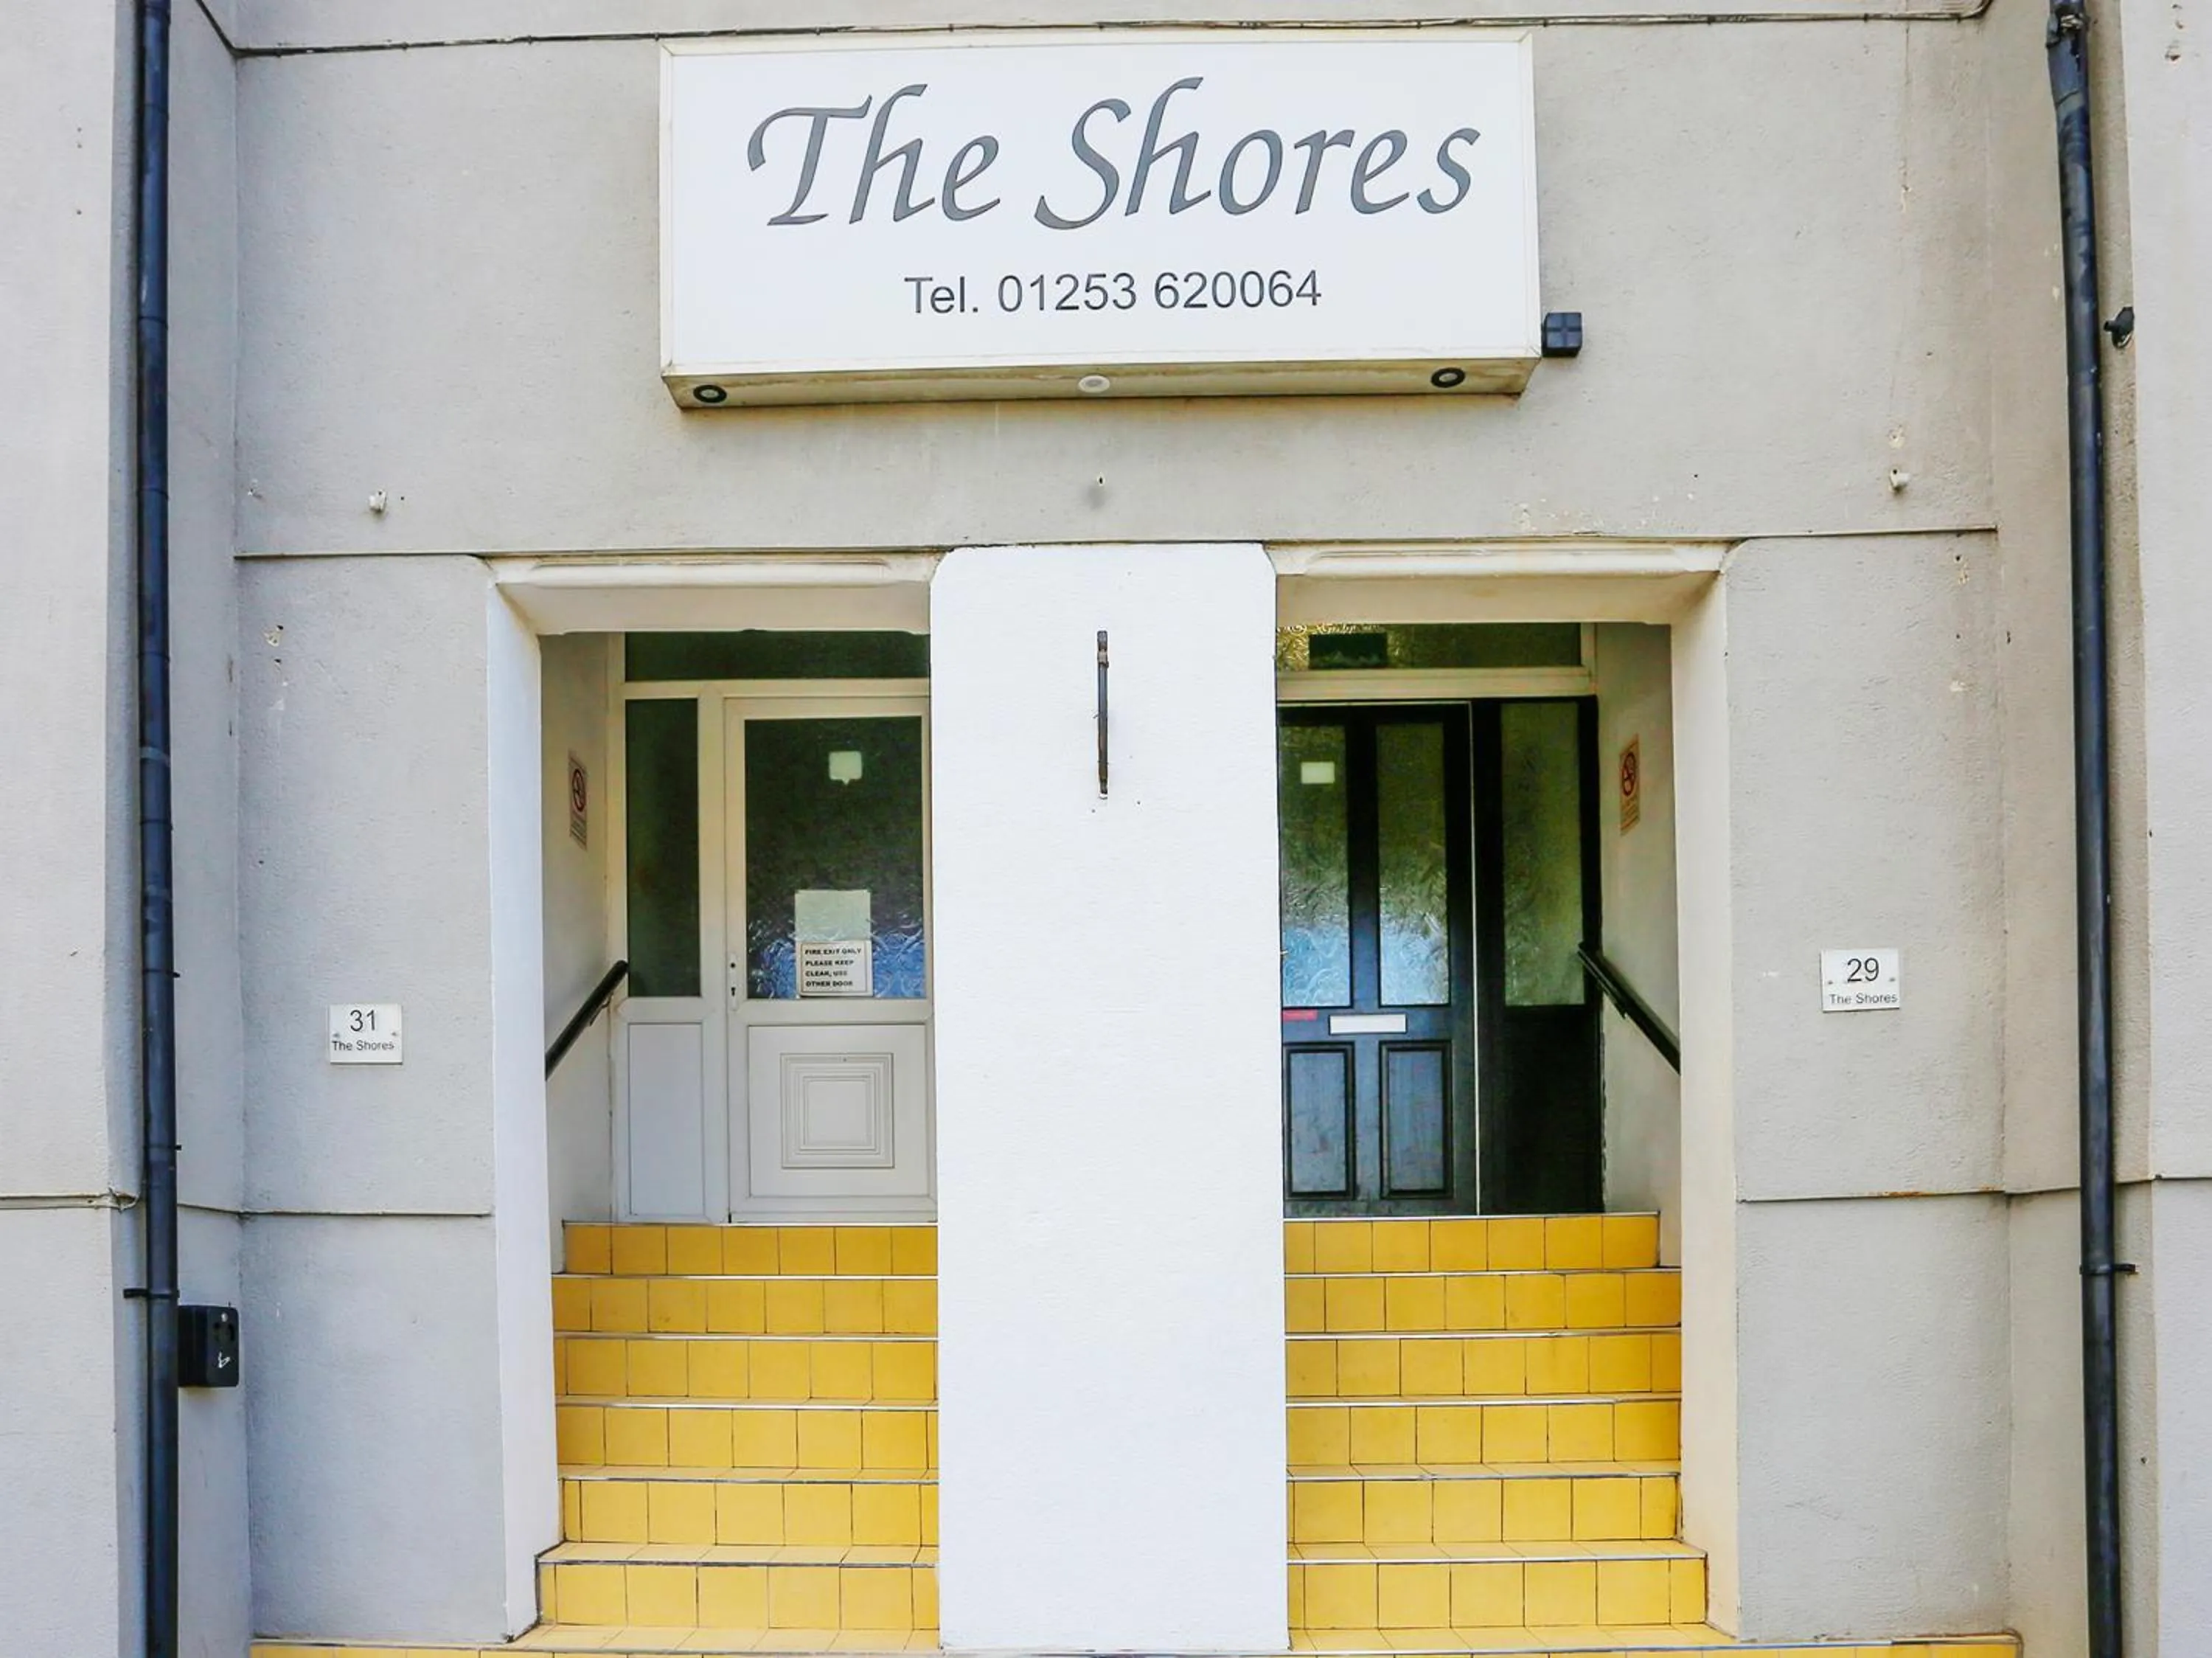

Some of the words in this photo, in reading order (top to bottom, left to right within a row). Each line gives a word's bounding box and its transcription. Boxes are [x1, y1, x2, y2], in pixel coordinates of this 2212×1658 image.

[748, 83, 1001, 226] The
[1034, 76, 1481, 230] Shores
[904, 276, 979, 314] Tel.
[998, 273, 1137, 313] 01253
[1154, 269, 1322, 309] 620064
[1847, 957, 1879, 983] 29
[1829, 993, 1852, 1004] The
[1855, 992, 1898, 1004] Shores
[350, 1009, 375, 1032] 31
[332, 1040, 353, 1051] The
[355, 1039, 394, 1051] Shores
